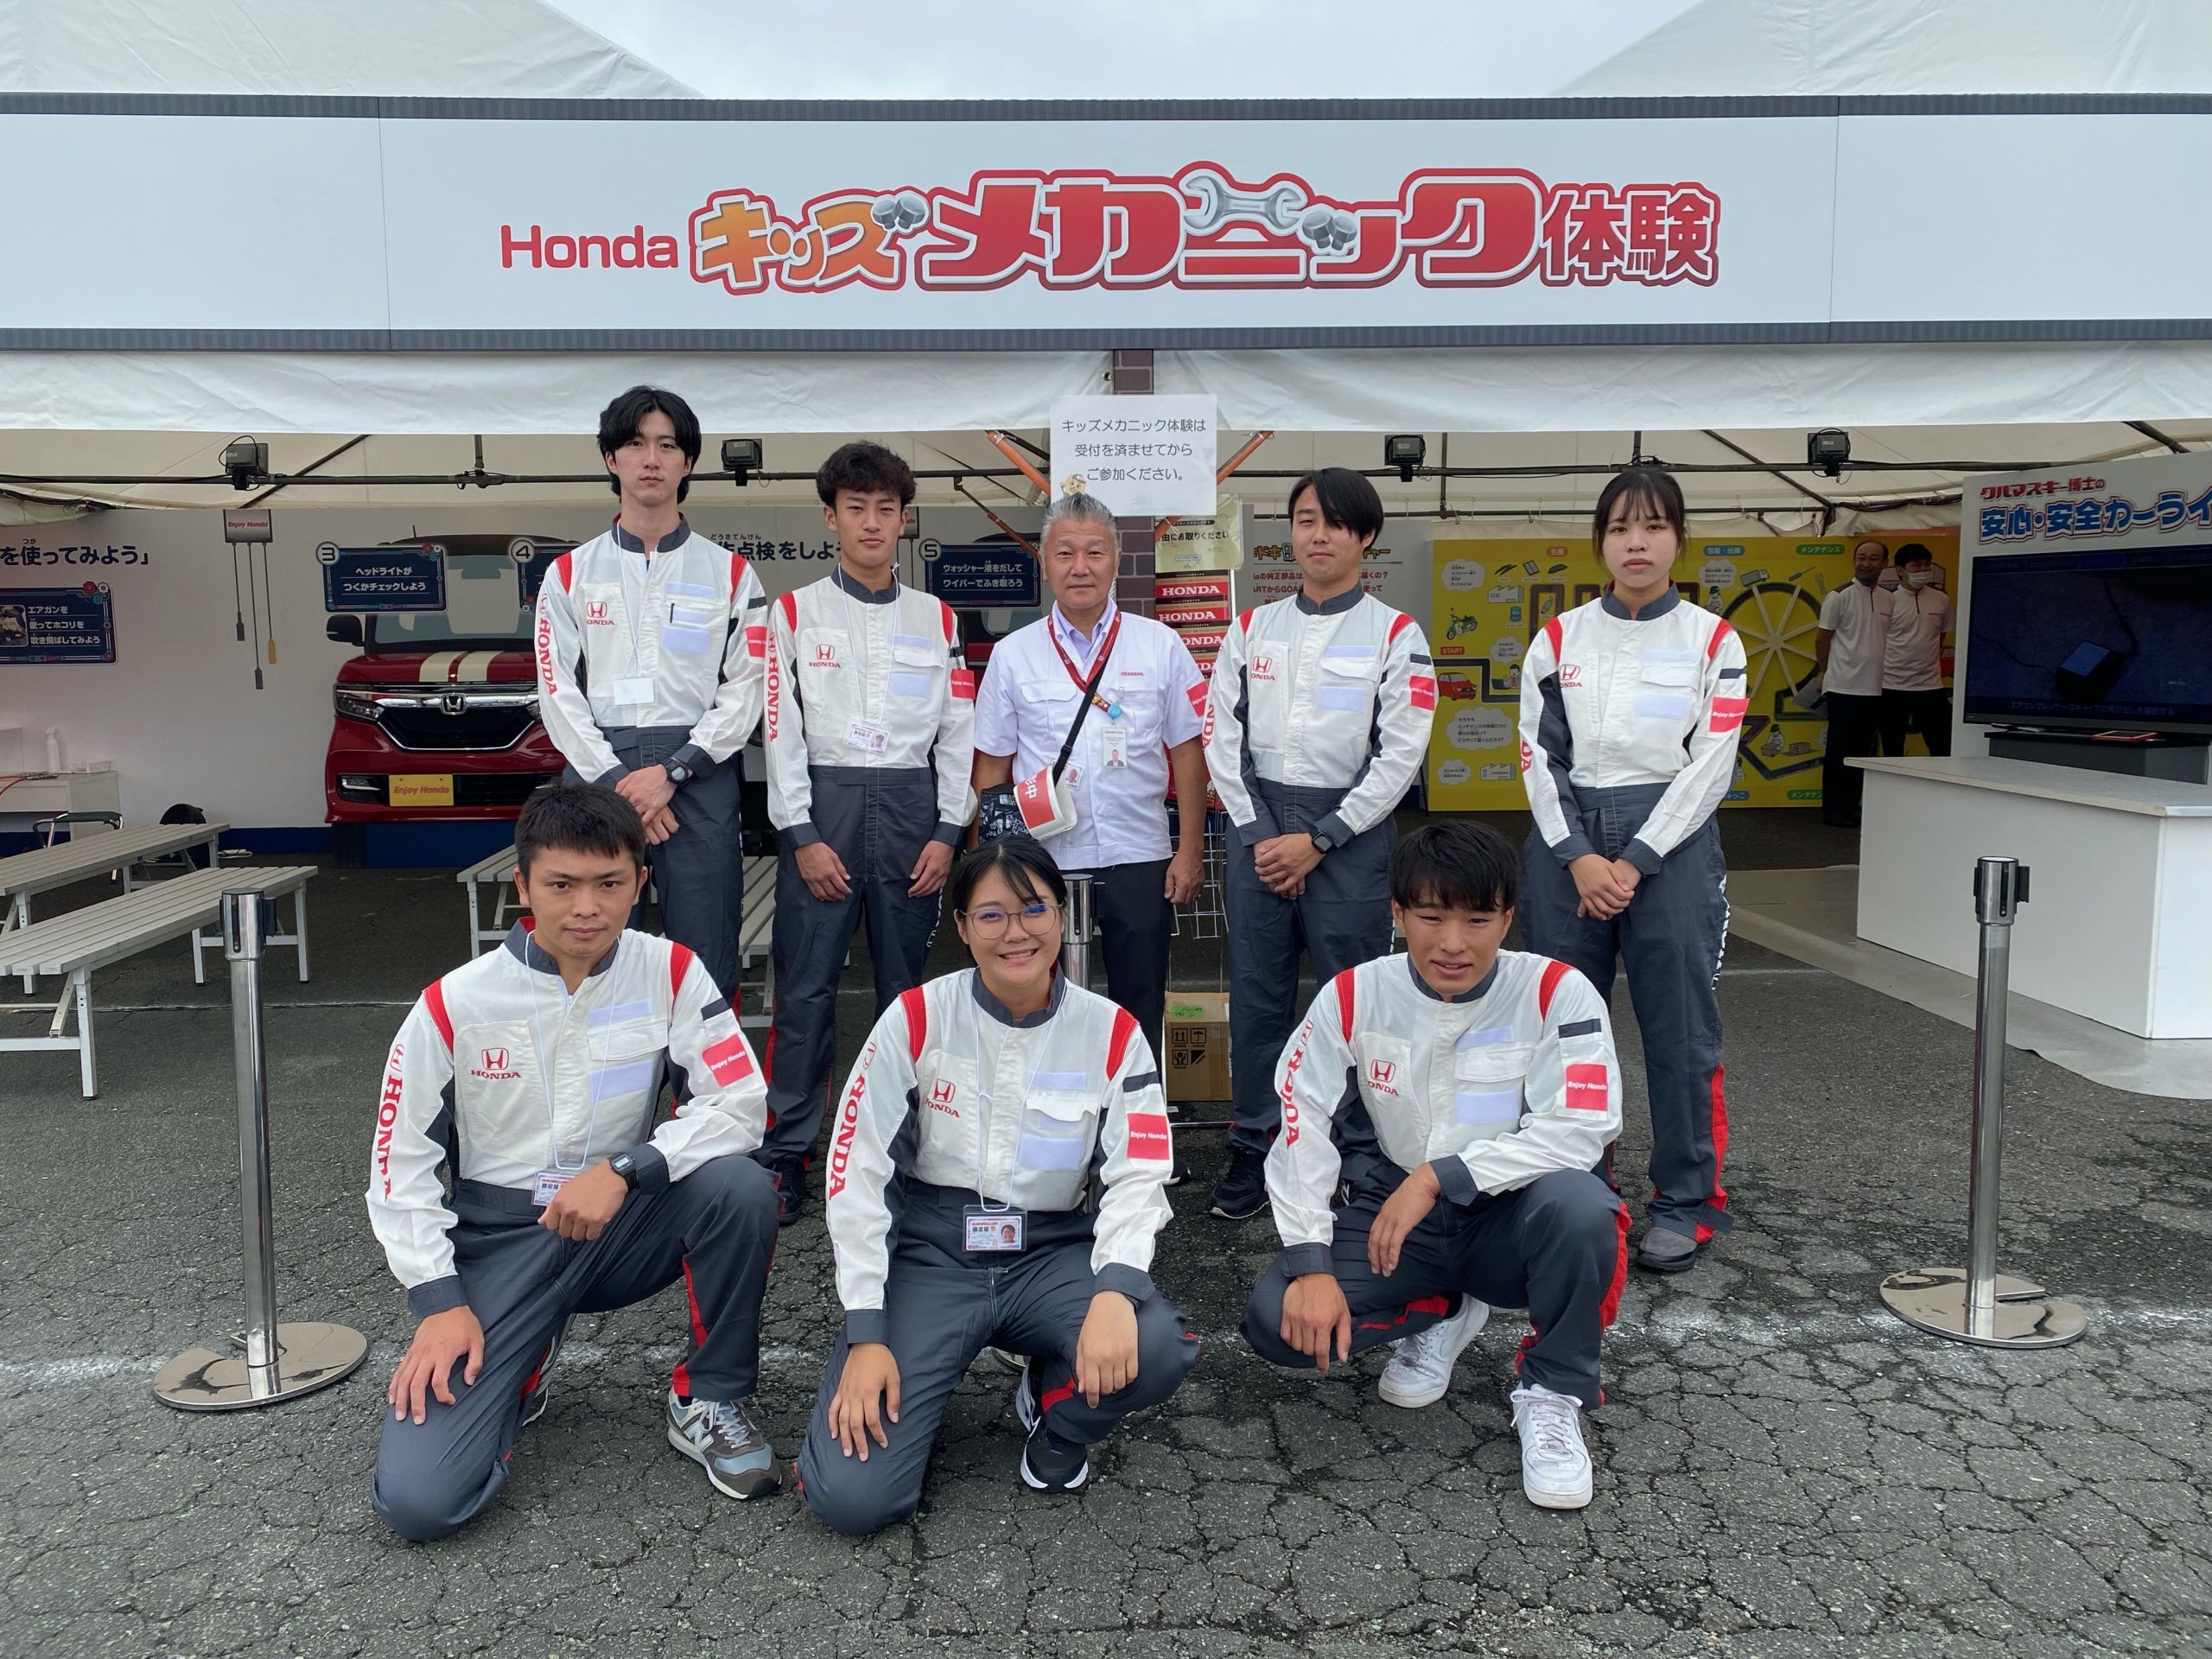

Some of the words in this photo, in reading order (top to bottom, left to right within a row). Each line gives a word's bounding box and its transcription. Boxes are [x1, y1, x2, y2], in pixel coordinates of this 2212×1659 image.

[499, 224, 679, 270] Honda
[1061, 418, 1207, 433] キッズメカニック体験は
[1074, 443, 1193, 457] 受付を済ませてから
[1086, 467, 1184, 481] ご参加ください。
[1980, 477, 2105, 500] クルマスキー博士の
[227, 521, 245, 530] Enjoy
[515, 545, 531, 559] 4
[355, 566, 413, 577] ヘッドライトが
[943, 563, 1023, 573] ウォッシャー液をだして
[343, 581, 427, 593] つくかチェックしよう
[943, 579, 1023, 588] ワイパーでふき取ろう
[1161, 585, 1221, 596] HONDA
[28, 606, 68, 614] エアガンを
[1158, 611, 1217, 622] HONDA
[29, 620, 85, 630] 使ってホコリを
[1181, 635, 1224, 645] ONDA
[537, 617, 557, 696] HONDA
[1251, 672, 1276, 681] ONDA
[767, 655, 779, 742] HONDA
[393, 785, 417, 795] Enjoy
[420, 785, 449, 794] Honda
[711, 1058, 728, 1071] Enjoy
[728, 1050, 747, 1063] Honda
[470, 1069, 522, 1080] HONDA
[1368, 1080, 1400, 1096] ONDA
[1567, 1081, 1586, 1090] Enjoy
[829, 1072, 866, 1200] HONDA
[1130, 1130, 1147, 1141] Enjoy
[1147, 1132, 1167, 1141] Honda
